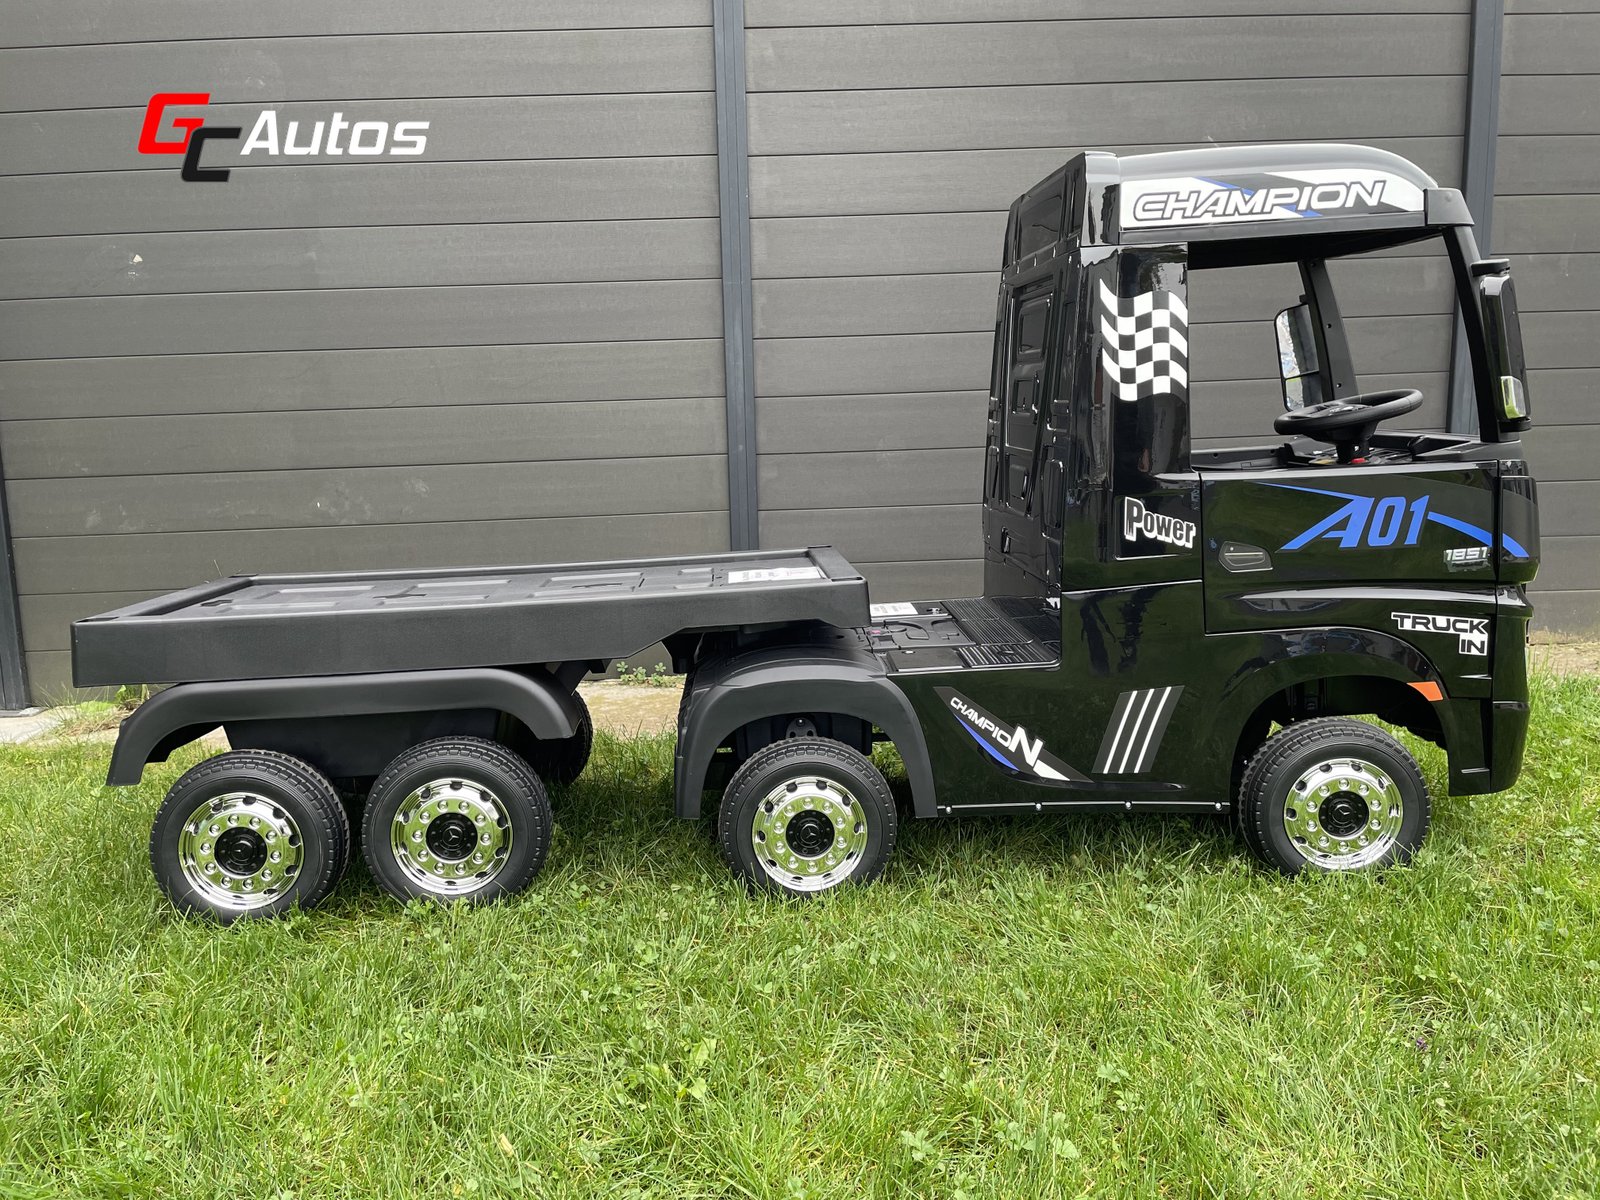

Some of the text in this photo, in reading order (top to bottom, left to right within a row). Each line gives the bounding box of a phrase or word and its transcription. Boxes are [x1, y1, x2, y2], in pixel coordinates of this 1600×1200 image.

[1133, 180, 1387, 221] CHAMPION
[1124, 496, 1196, 548] Power
[1276, 495, 1430, 550] A01
[1445, 546, 1488, 561] 1851
[1391, 612, 1488, 634] TRUCK
[1459, 638, 1486, 655] IN
[950, 696, 1044, 768] CHAMPION
